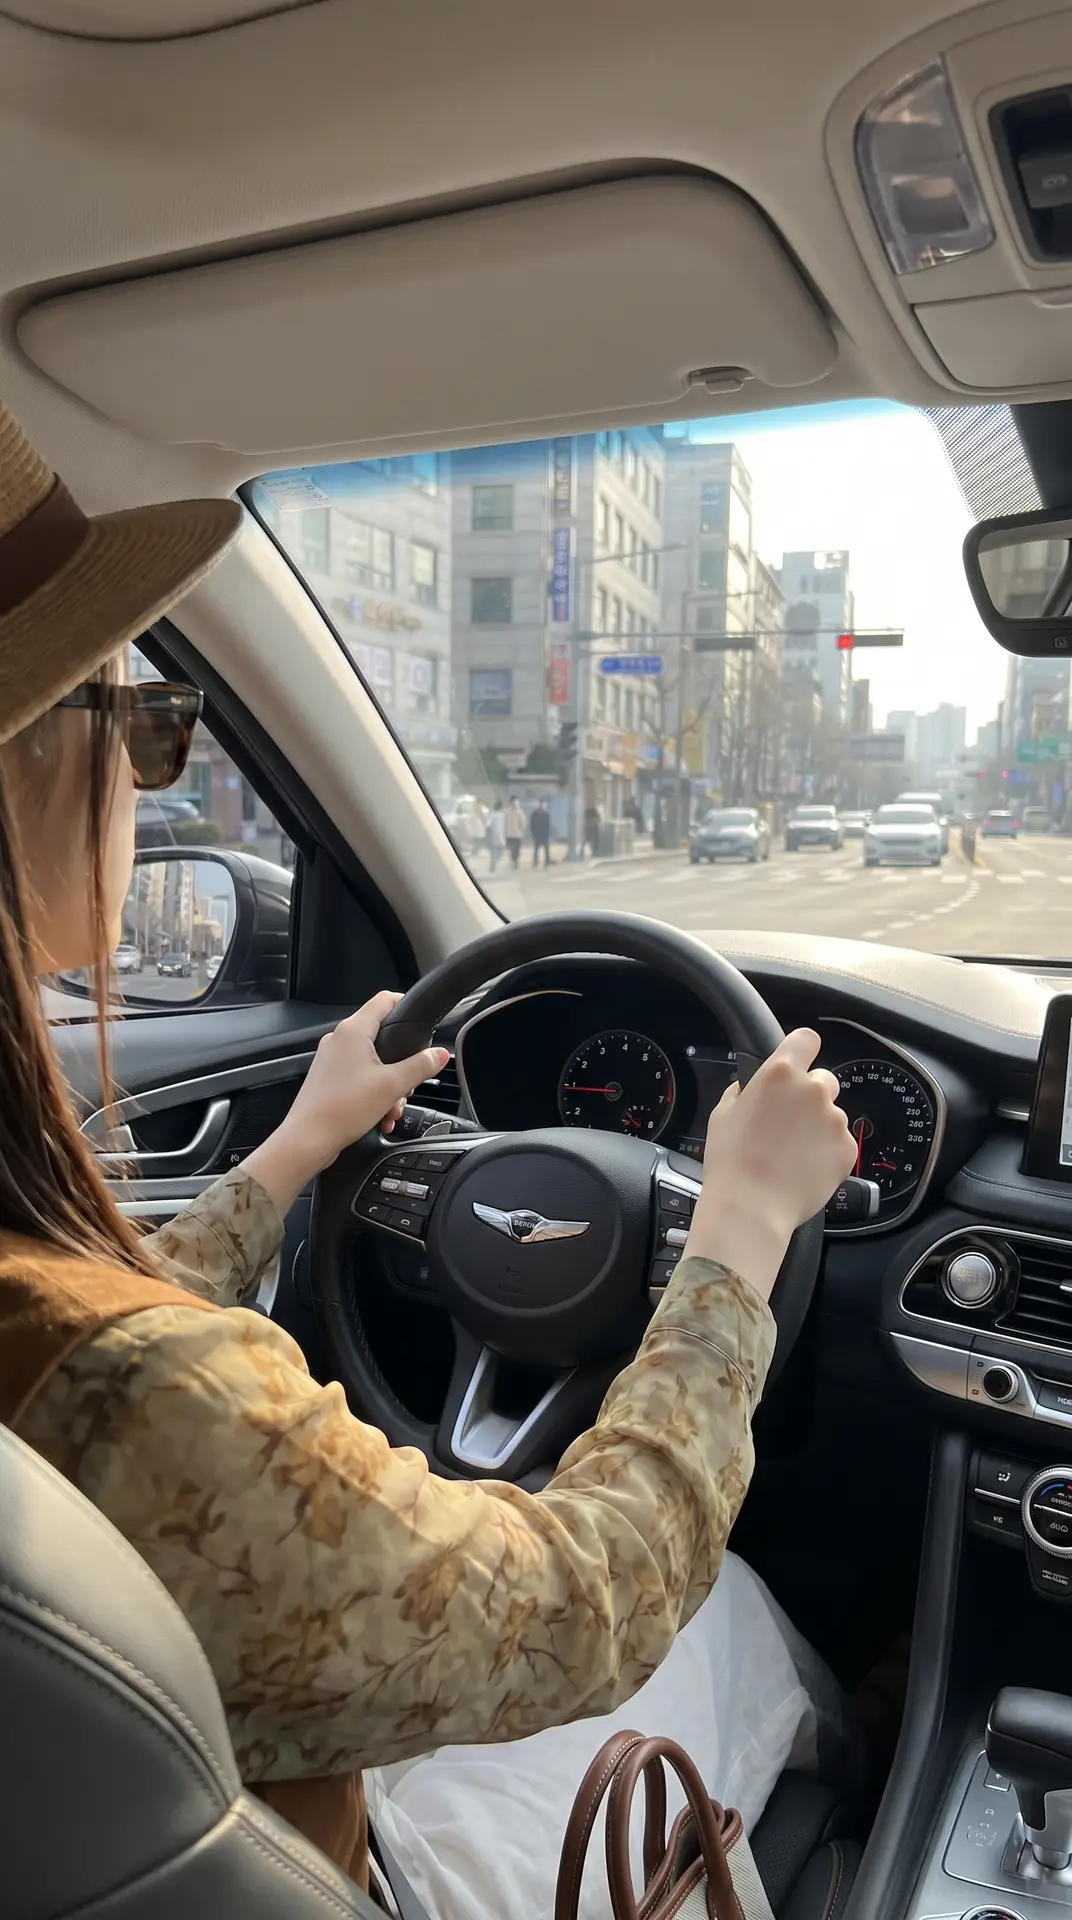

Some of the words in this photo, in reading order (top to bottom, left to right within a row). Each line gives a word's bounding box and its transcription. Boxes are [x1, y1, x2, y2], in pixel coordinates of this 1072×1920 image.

[600, 1047, 605, 1055] 3
[622, 1043, 628, 1051] 4
[642, 1053, 648, 1061] 5
[655, 1071, 661, 1079] 6
[867, 1072, 879, 1080] 120
[574, 1107, 580, 1115] 2
